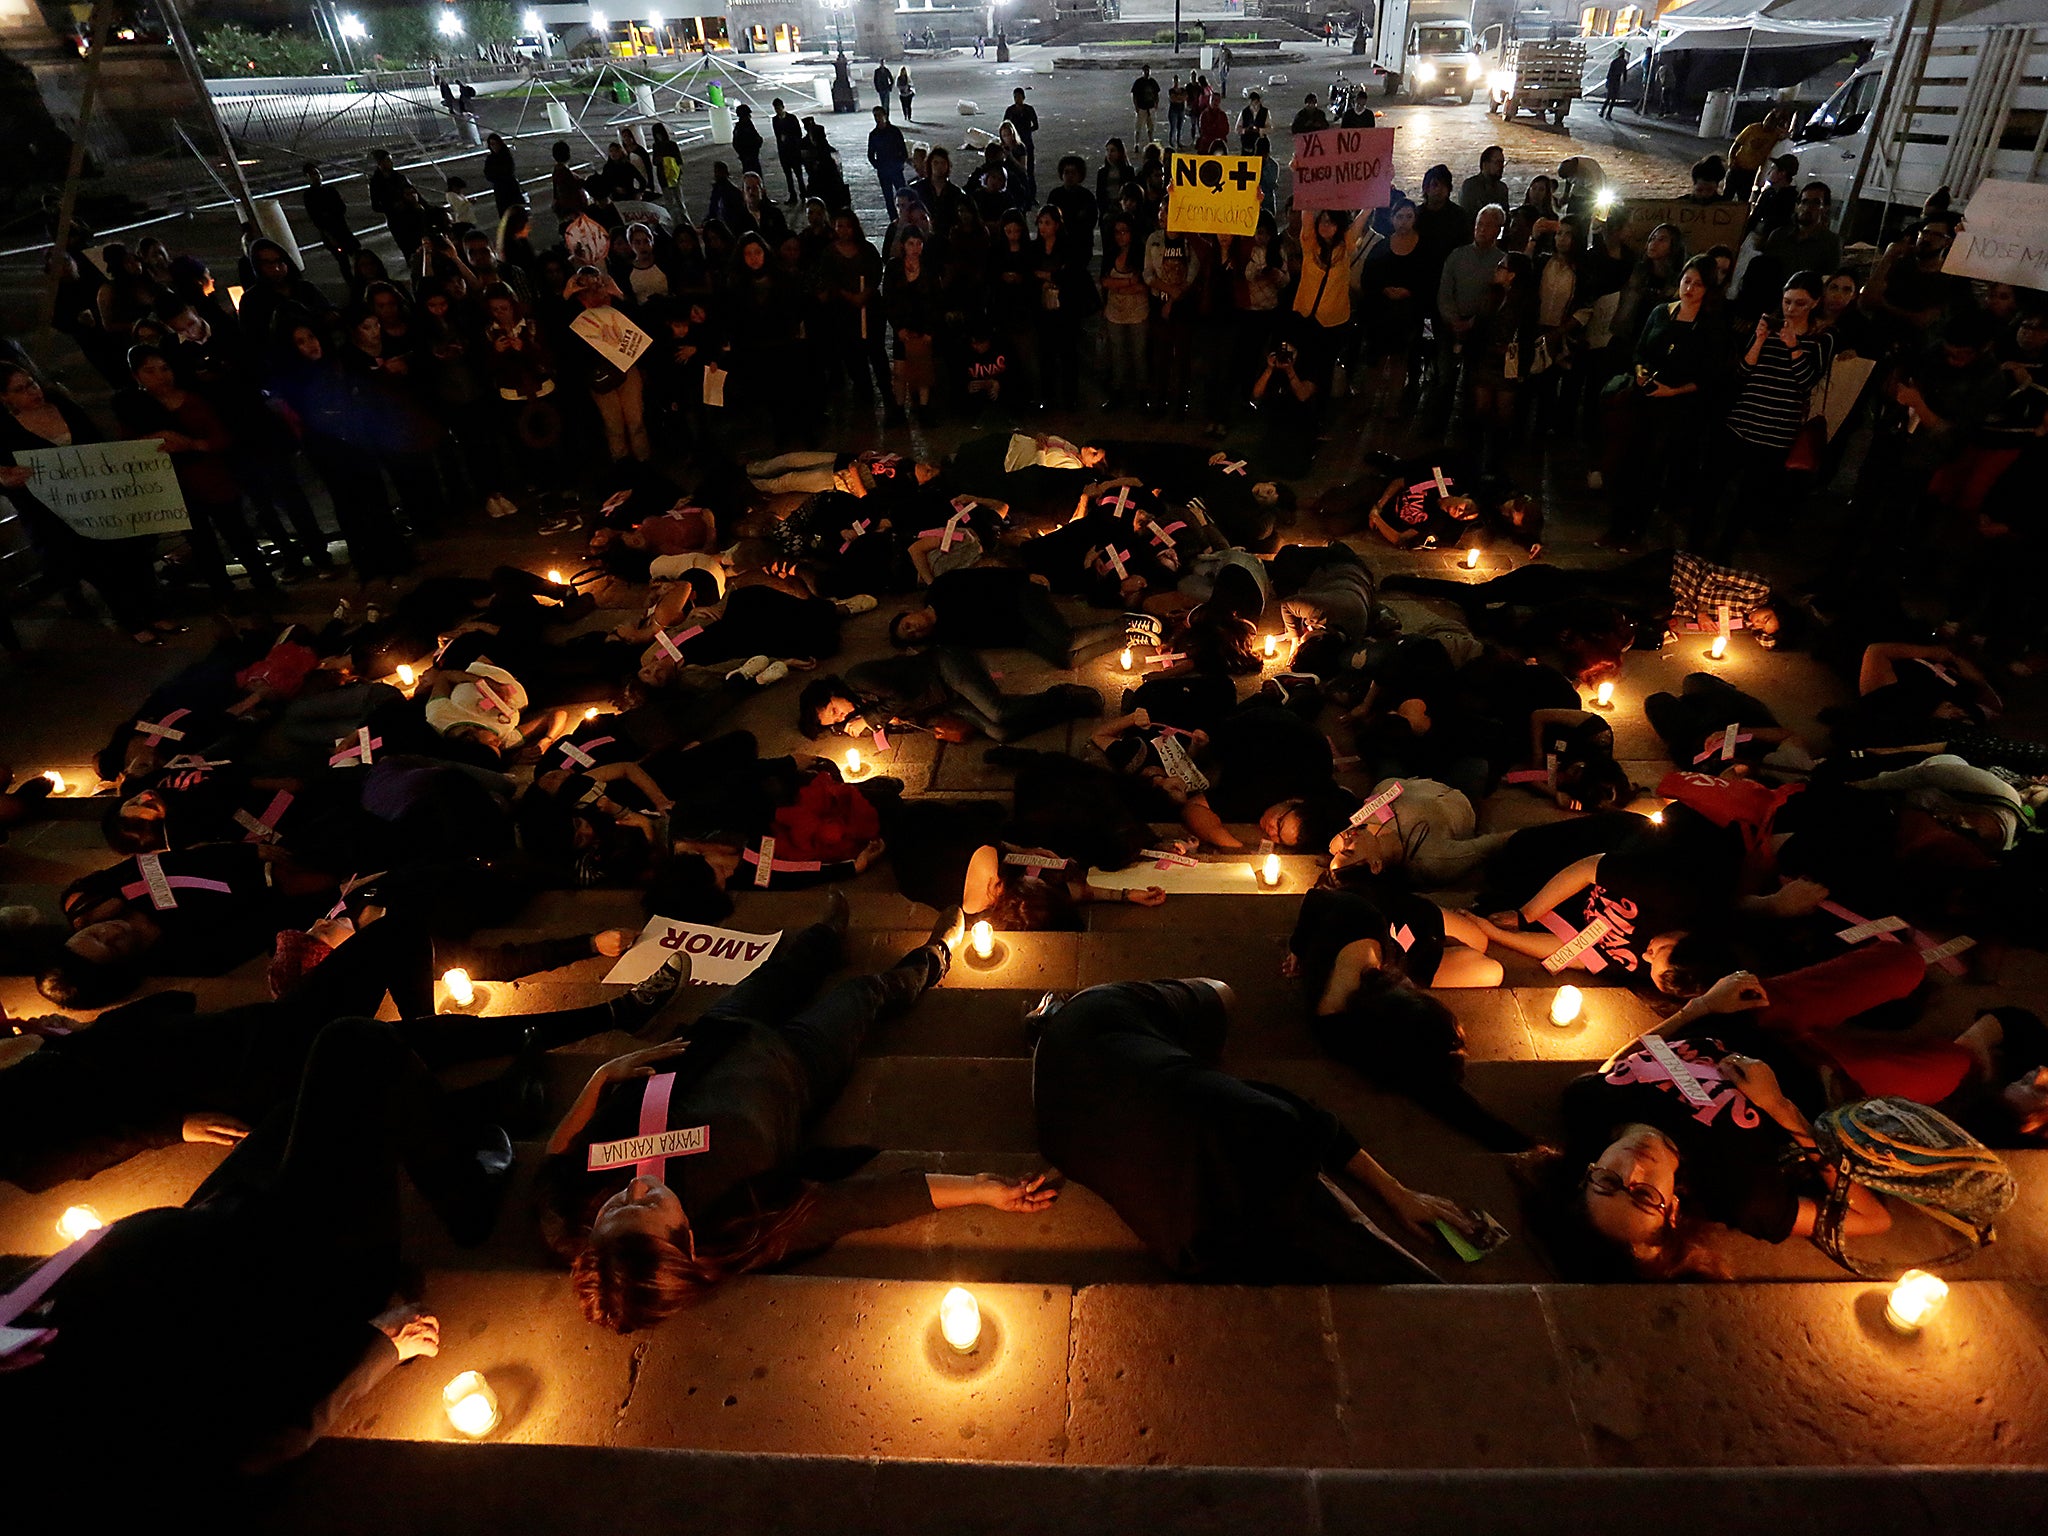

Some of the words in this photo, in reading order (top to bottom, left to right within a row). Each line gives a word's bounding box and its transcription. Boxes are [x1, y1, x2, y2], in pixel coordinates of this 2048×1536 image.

[1302, 134, 1325, 158] YA
[1337, 132, 1362, 154] NO
[1335, 159, 1382, 184] MIEDO
[619, 328, 635, 354] BASTA
[112, 482, 163, 500] menos
[659, 928, 769, 961] AMOR
[1572, 922, 1604, 949] HILDA
[1547, 946, 1575, 970] RUBI
[603, 1137, 656, 1163] KARINA
[659, 1129, 702, 1153] MAYRA
